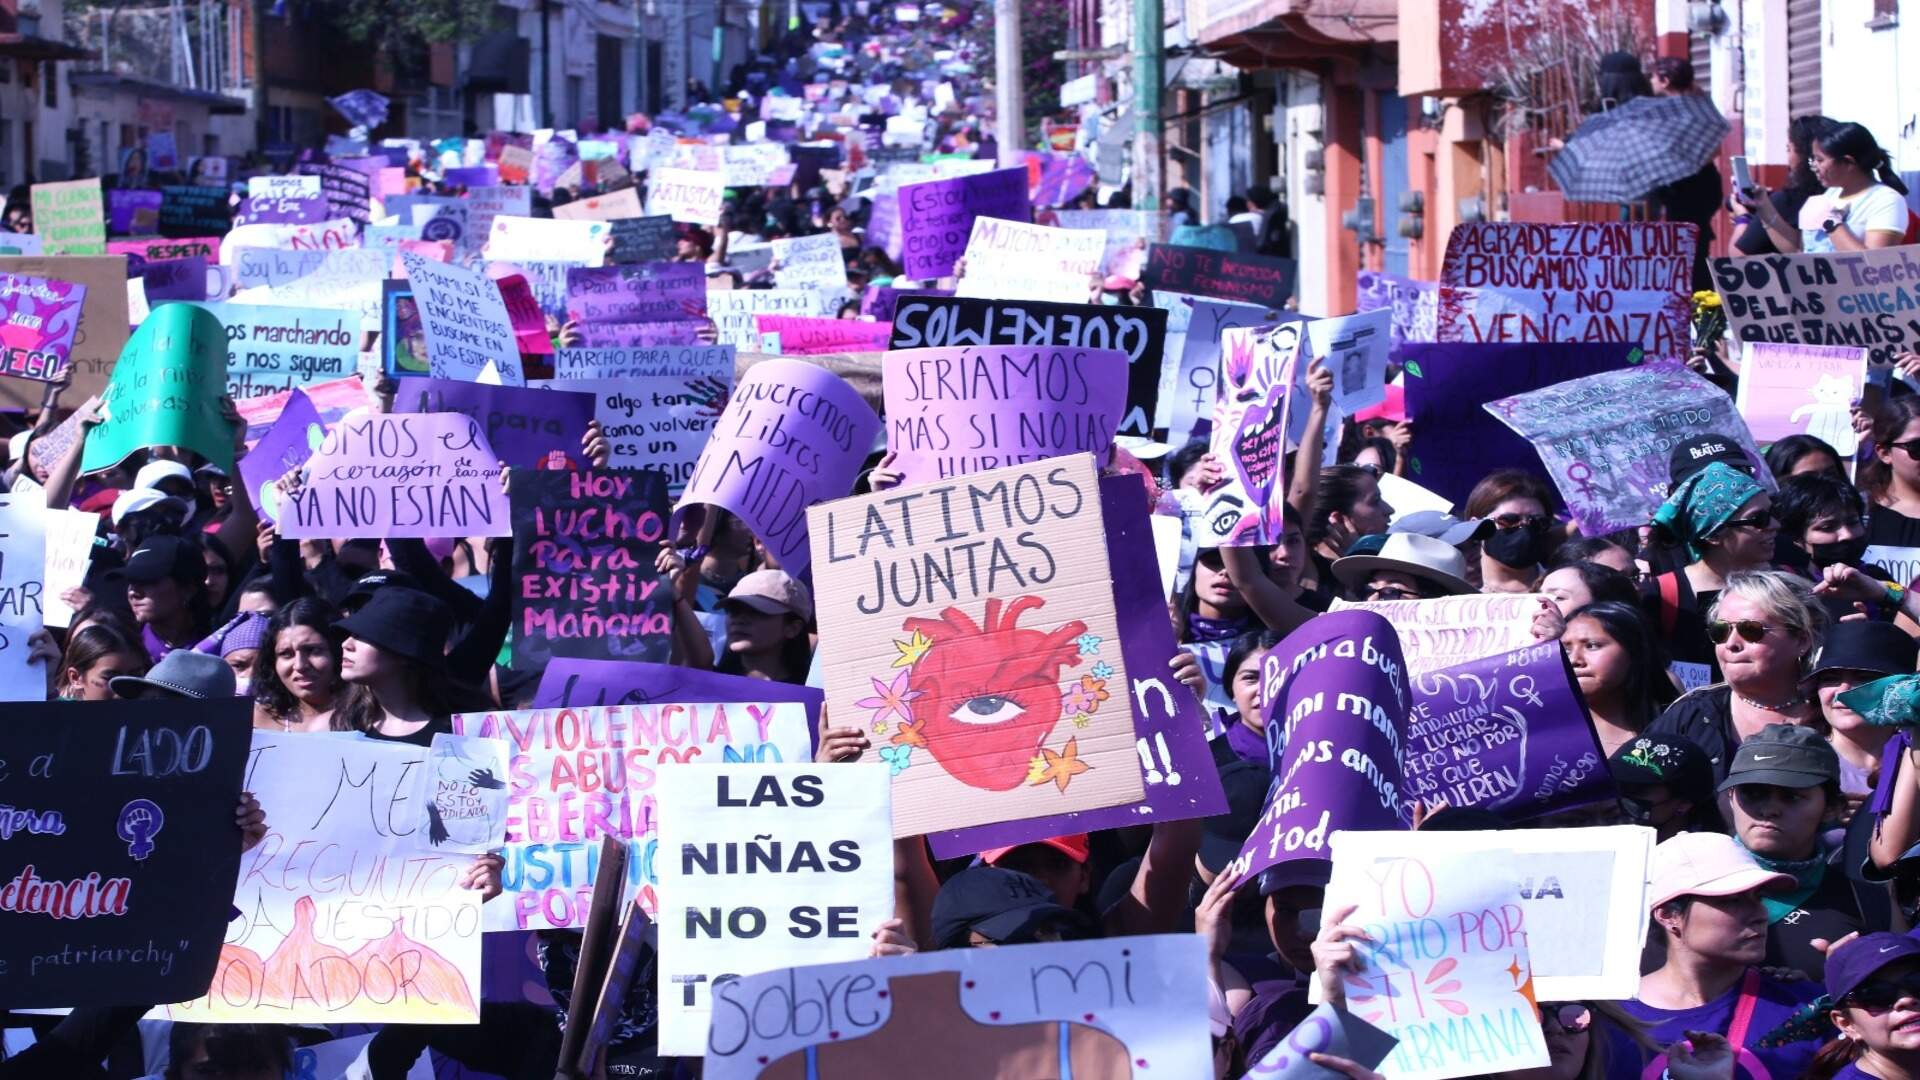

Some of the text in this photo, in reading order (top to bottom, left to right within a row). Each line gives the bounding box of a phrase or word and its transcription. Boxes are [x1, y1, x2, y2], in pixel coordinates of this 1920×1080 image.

[147, 244, 212, 258] RESPETA
[1461, 224, 1687, 258] AGRADEZCAN QUE
[1153, 248, 1284, 283] NO TE INCOMODA
[1463, 253, 1694, 293] BUSCAMOS JUSTICIA
[1712, 252, 1920, 294] SOY LA Teach
[422, 269, 481, 298] MAMI SI
[1160, 268, 1181, 286] EL
[1192, 274, 1275, 300] FEMINISMO
[430, 287, 482, 317] NO ME
[728, 292, 809, 311] la Mamá
[1541, 290, 1614, 315] Y NO
[1726, 293, 1767, 320] DE
[1767, 291, 1827, 318] LAS
[253, 320, 352, 346] marchando
[425, 300, 508, 339] ENCUENTRAS
[430, 319, 504, 353] BUSCAME EN
[892, 302, 1151, 363] QUEREMOS
[1466, 310, 1678, 356] VENGANZA
[1739, 312, 1906, 347] QUE JAMAS
[246, 350, 342, 381] nos siguen
[435, 342, 459, 360] LAS
[558, 349, 730, 369] MARCHO PARA QUE A
[904, 348, 1089, 404] SERÍAMOS
[606, 392, 642, 418] algo
[736, 381, 860, 451] queremos
[319, 417, 483, 459] OMOS el
[602, 417, 709, 439] como volver
[735, 410, 823, 475] Libres
[894, 406, 1111, 454] MÁS SI NO LAS
[454, 456, 473, 469] de
[613, 440, 678, 457] es un
[1689, 443, 1726, 461] BEATLES
[318, 459, 442, 484] corazón
[453, 467, 502, 481] las qu
[291, 479, 493, 528] YA NO ESTÁN
[825, 467, 1084, 565] LATIMOS
[856, 531, 1057, 615] JUNTAS
[522, 605, 672, 640] Mañana
[504, 703, 733, 752] VIOLENCIA
[745, 703, 777, 743] Y
[1423, 717, 1500, 752] LUCHAR,
[28, 753, 55, 778] a
[111, 724, 213, 777] LADO
[1403, 725, 1521, 778] PERO NO POR
[310, 756, 424, 838] ME
[436, 792, 483, 807] ESTOY
[438, 780, 459, 793] NO
[716, 775, 825, 808] LAS
[1340, 749, 1402, 818] amiga
[506, 790, 658, 843] EBERIA
[681, 833, 862, 875] NIÑAS
[1228, 809, 1335, 877] or tod
[242, 832, 458, 904] REGUNTO
[1364, 857, 1437, 919] YO
[685, 905, 861, 939] NO SE
[1364, 903, 1530, 968] RITO POR
[205, 949, 440, 1012] IOLADOR
[1030, 948, 1136, 1014] mi
[1369, 968, 1426, 1023] TI
[707, 967, 880, 1057] Sobre
